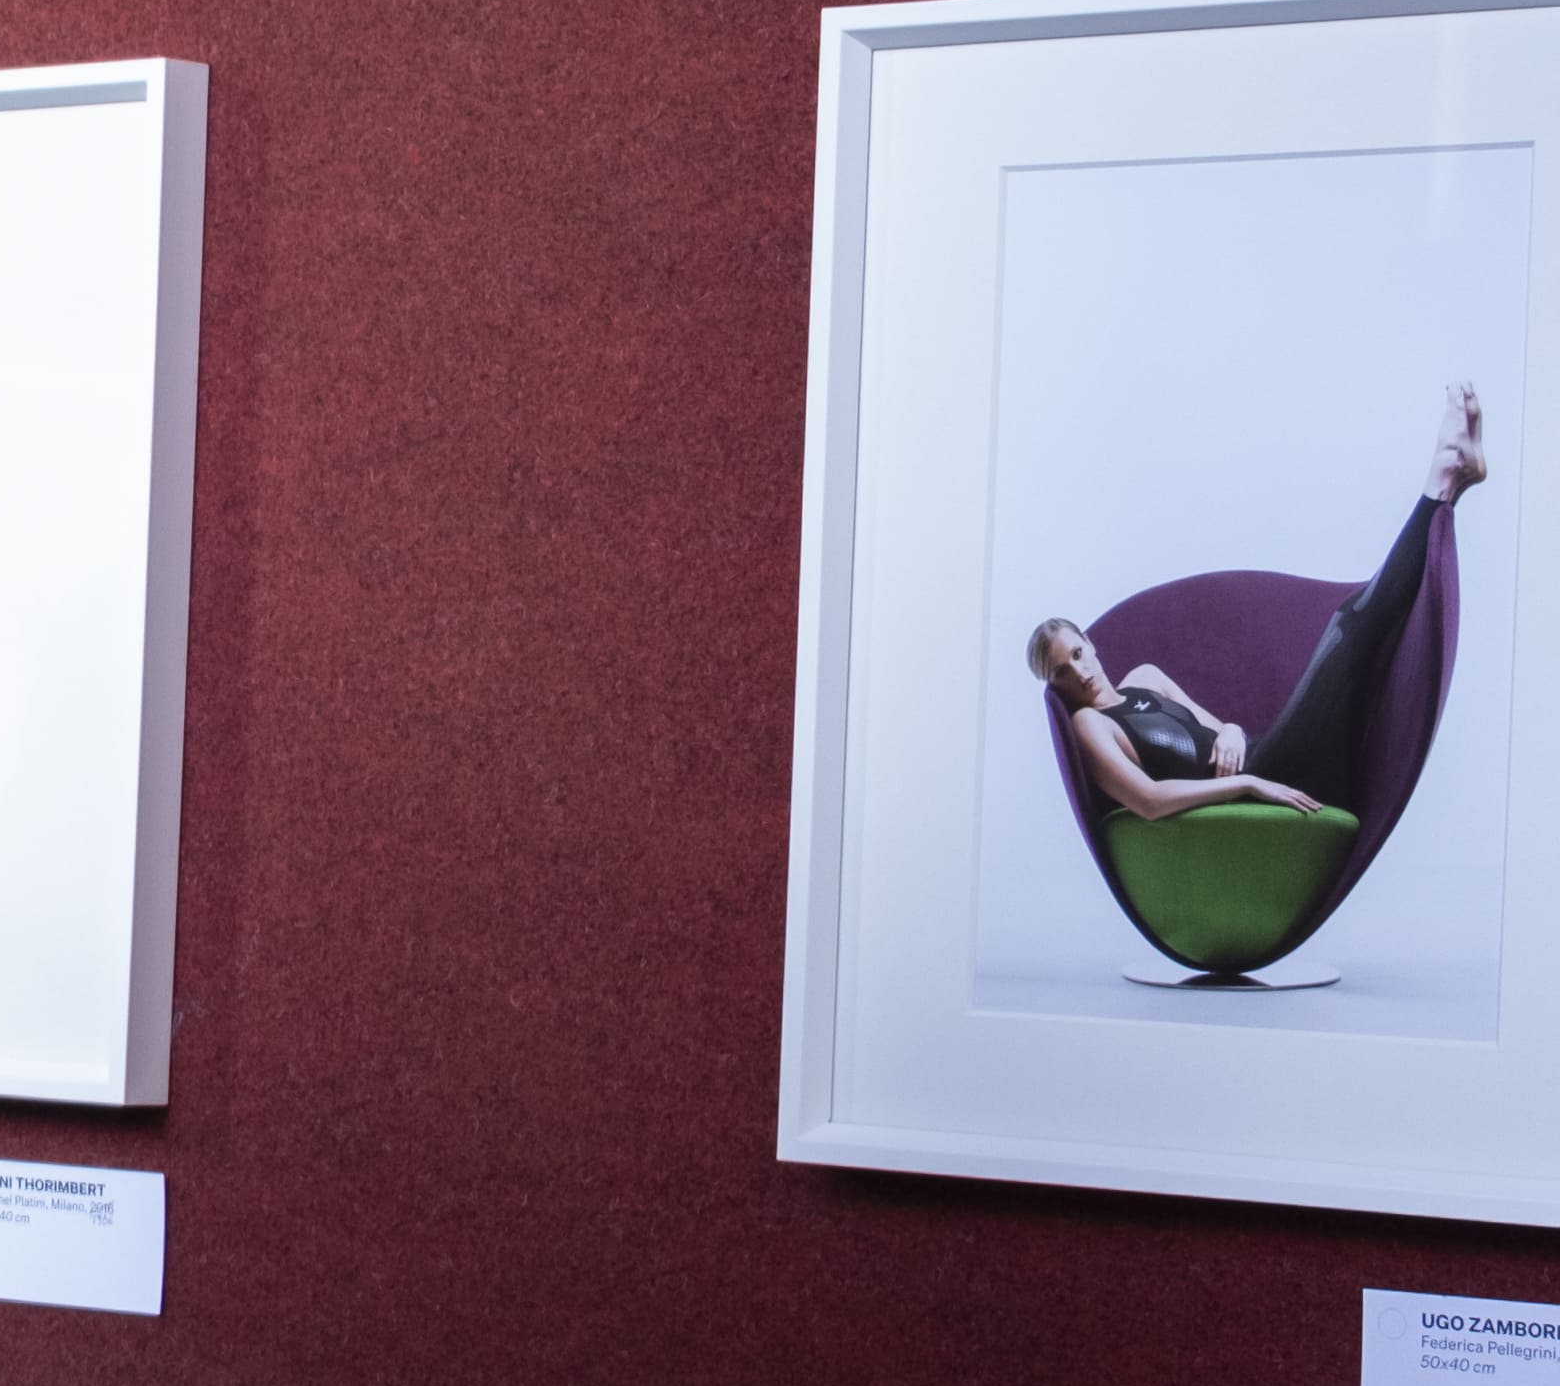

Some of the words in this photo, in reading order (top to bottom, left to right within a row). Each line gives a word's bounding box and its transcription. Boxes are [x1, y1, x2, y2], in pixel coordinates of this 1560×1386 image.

[17, 1176, 107, 1197] THORIMBERT
[1421, 1312, 1464, 1331] UGO
[1420, 1334, 1484, 1353] Federica
[1420, 1354, 1470, 1372] 50x40
[1472, 1362, 1496, 1375] cm
